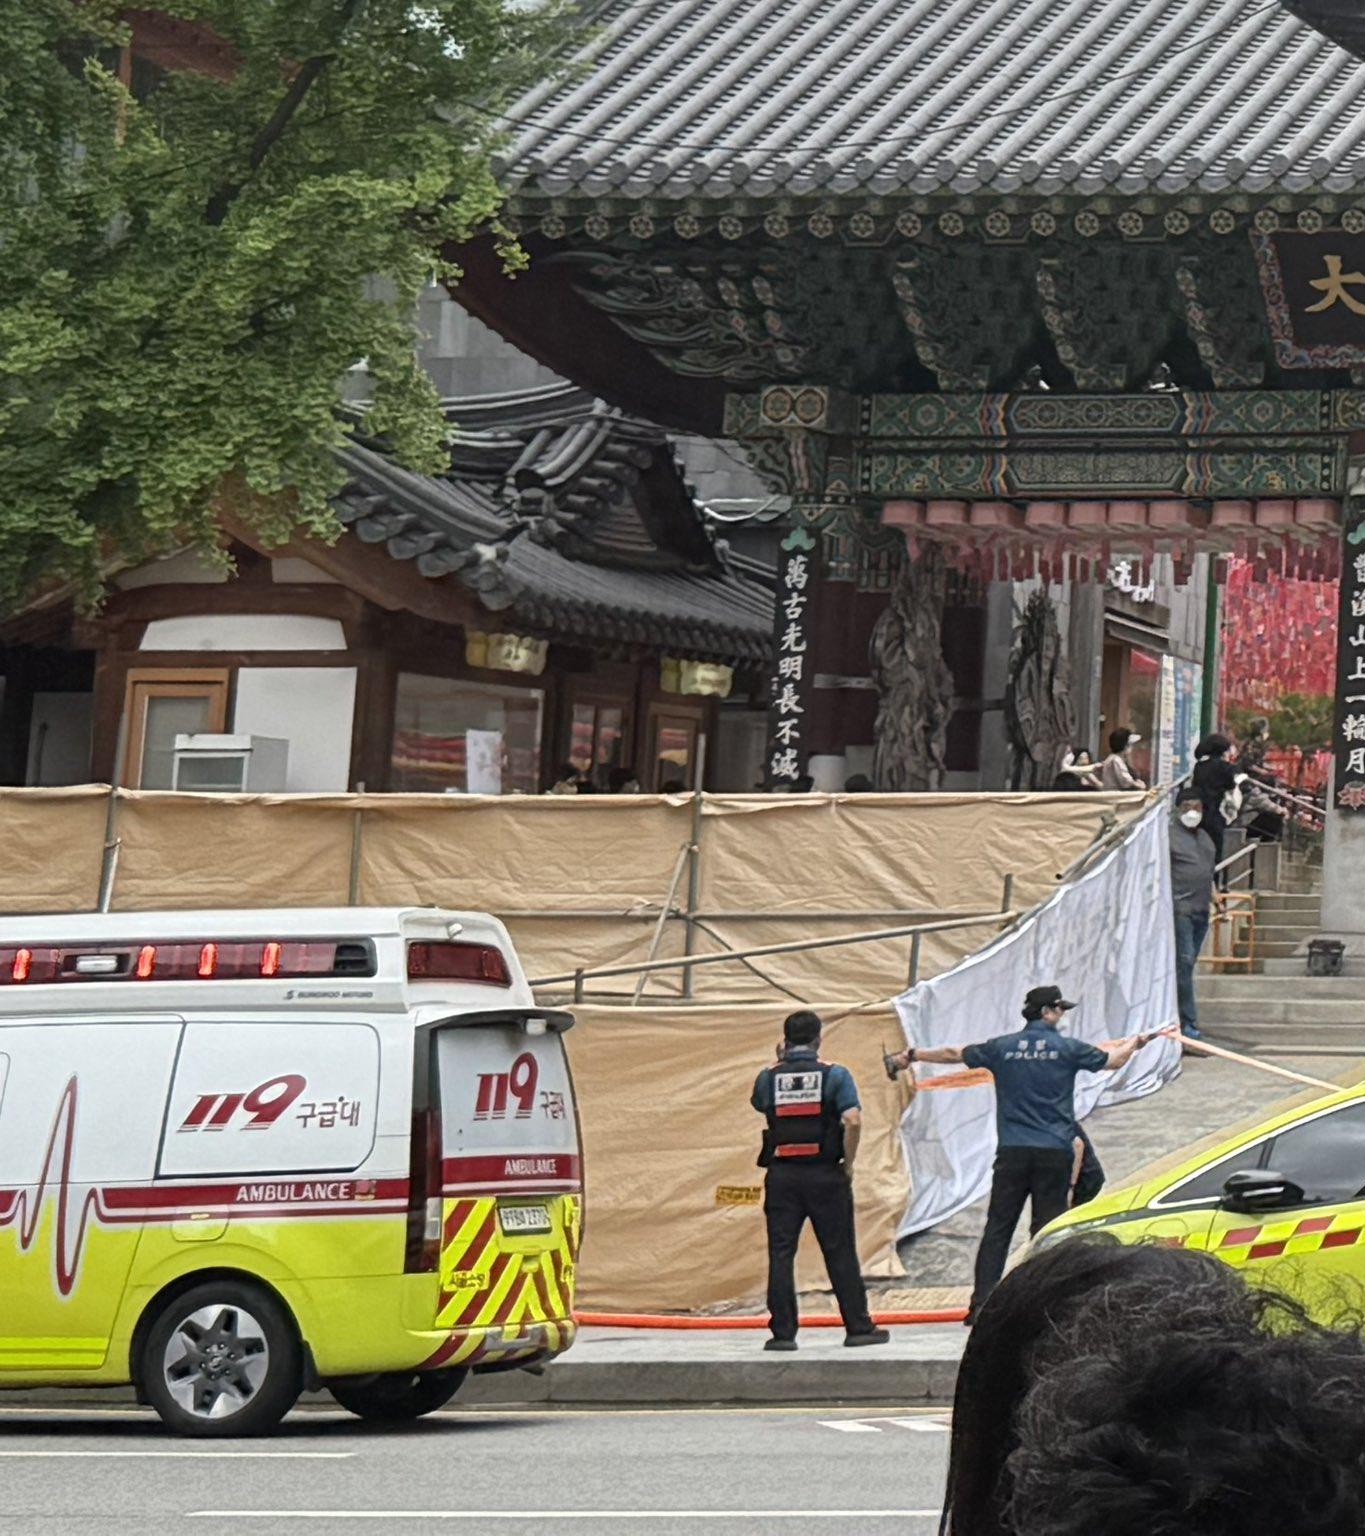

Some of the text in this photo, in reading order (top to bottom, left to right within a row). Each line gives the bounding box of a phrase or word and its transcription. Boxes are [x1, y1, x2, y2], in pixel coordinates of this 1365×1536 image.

[176, 1074, 361, 1133] 119 구급대
[473, 1052, 539, 1121] 119
[505, 1158, 557, 1175] AMBULANCE
[236, 1183, 350, 1202] AMBULANCE
